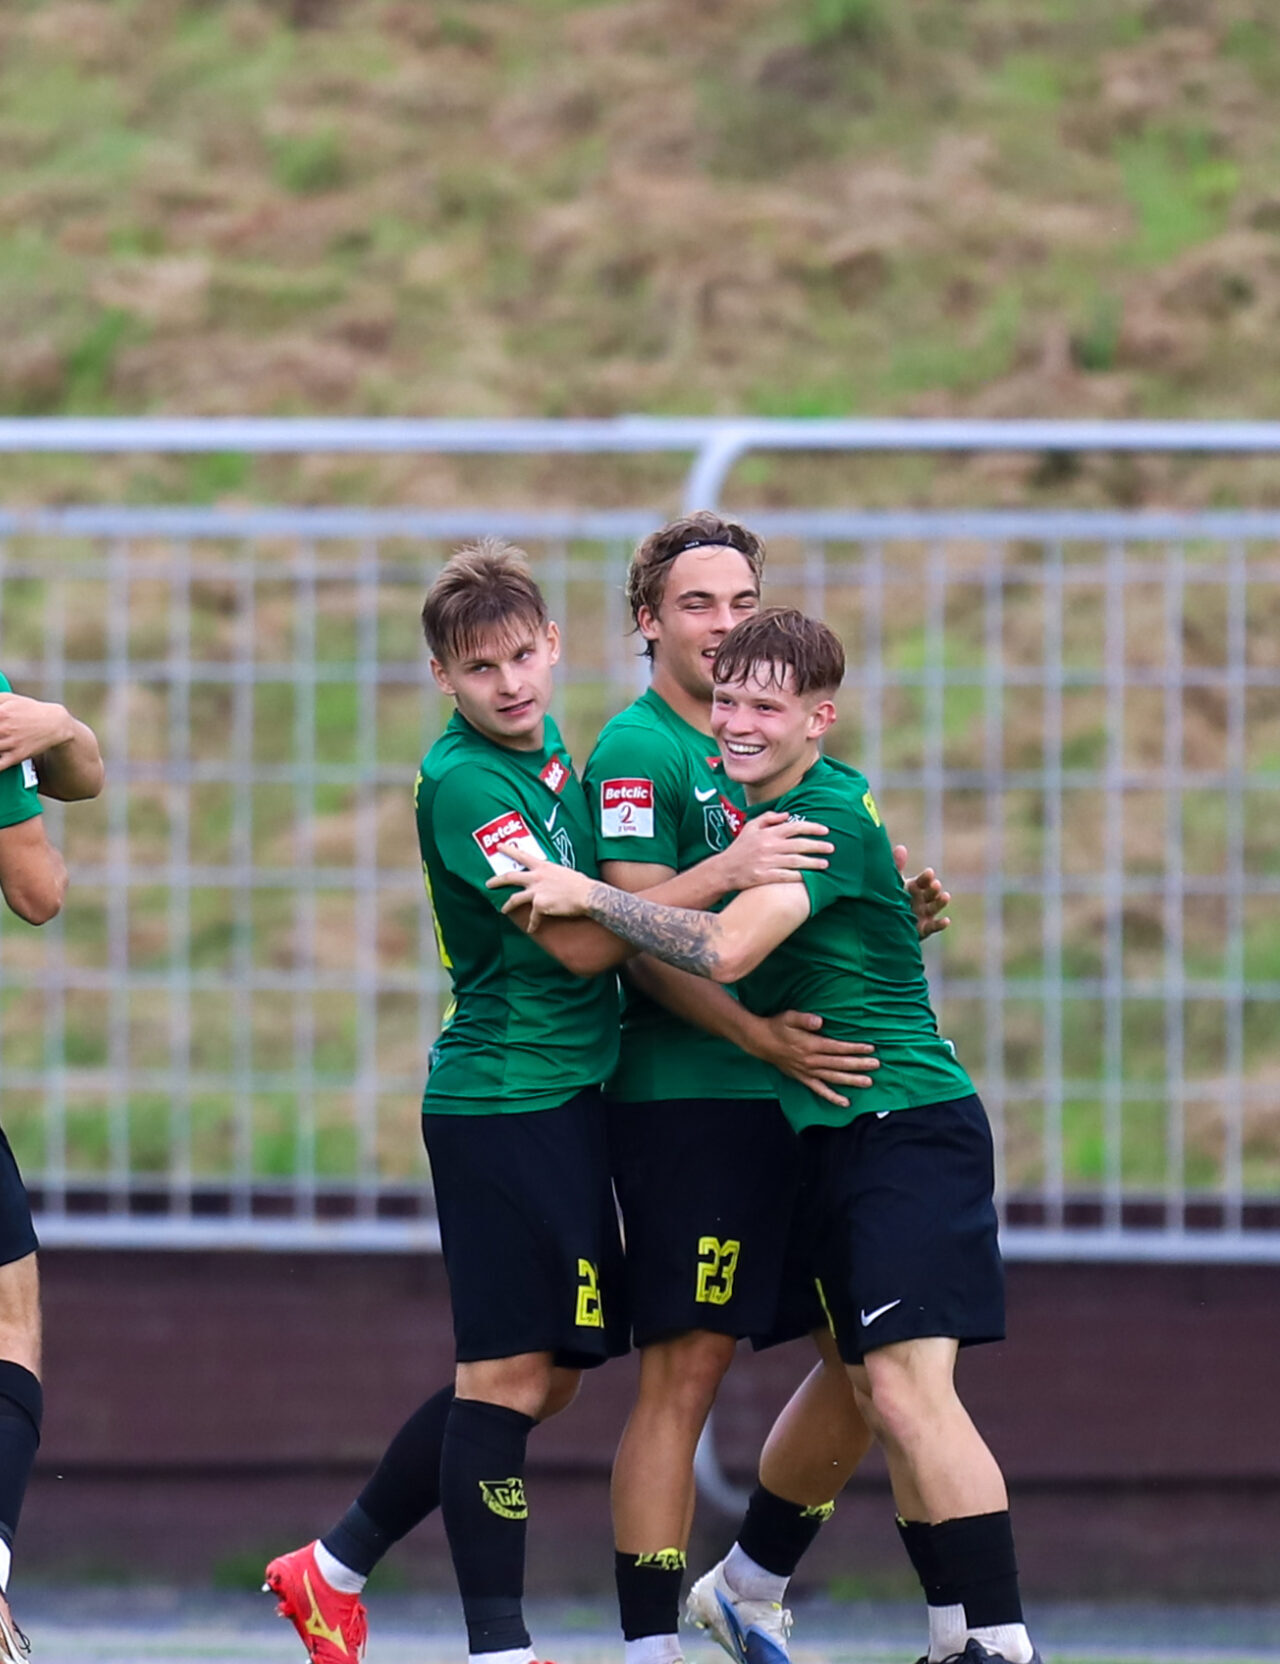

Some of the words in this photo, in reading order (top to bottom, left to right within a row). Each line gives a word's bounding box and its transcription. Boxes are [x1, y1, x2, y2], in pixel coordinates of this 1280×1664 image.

[605, 786, 649, 800] Betclic
[621, 804, 634, 824] 2
[481, 819, 523, 849] Betclic
[695, 1236, 740, 1305] 23
[575, 1258, 604, 1328] 2
